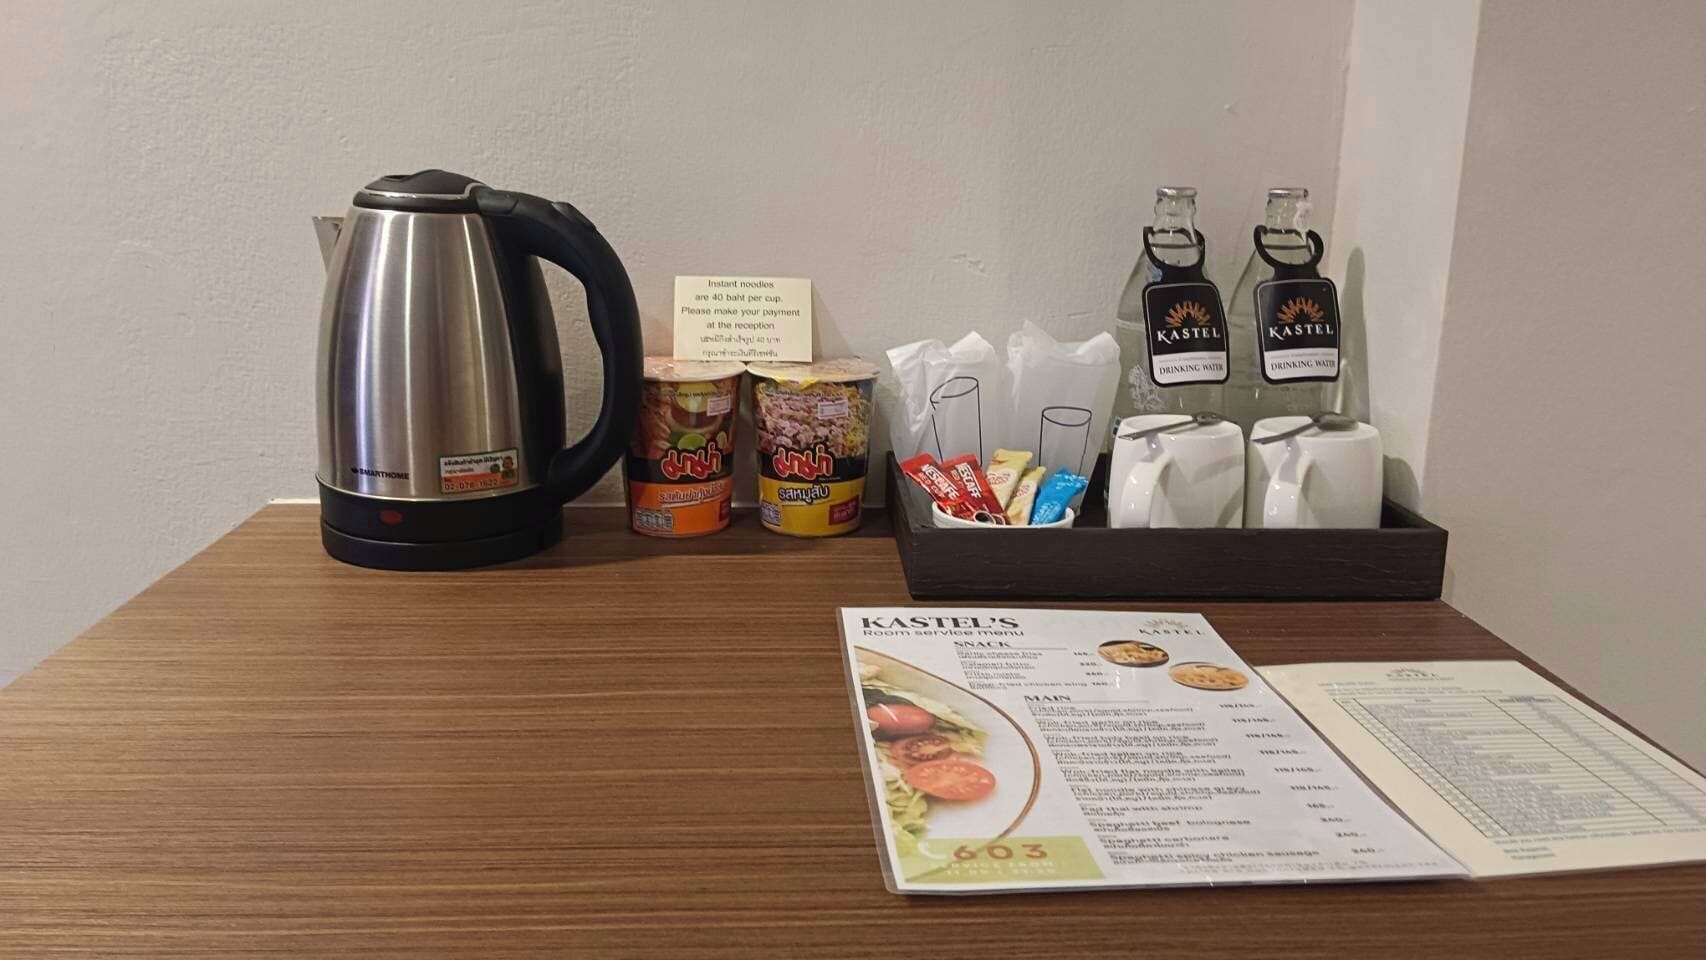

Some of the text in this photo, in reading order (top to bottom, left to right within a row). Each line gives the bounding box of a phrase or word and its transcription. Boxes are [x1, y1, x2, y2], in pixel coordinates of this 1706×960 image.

[708, 280, 774, 288] Instant noodles
[726, 294, 745, 302] baht
[748, 296, 762, 304] per
[681, 306, 800, 318] Please make your payment
[718, 321, 732, 329] the
[735, 322, 775, 330] reception
[1157, 327, 1221, 345] KASTEL
[1269, 323, 1334, 341] KASTEL
[1159, 362, 1224, 376] DRINKING WATER
[1271, 359, 1336, 371] DRINKING WATER
[360, 468, 409, 480] SMARTHOME
